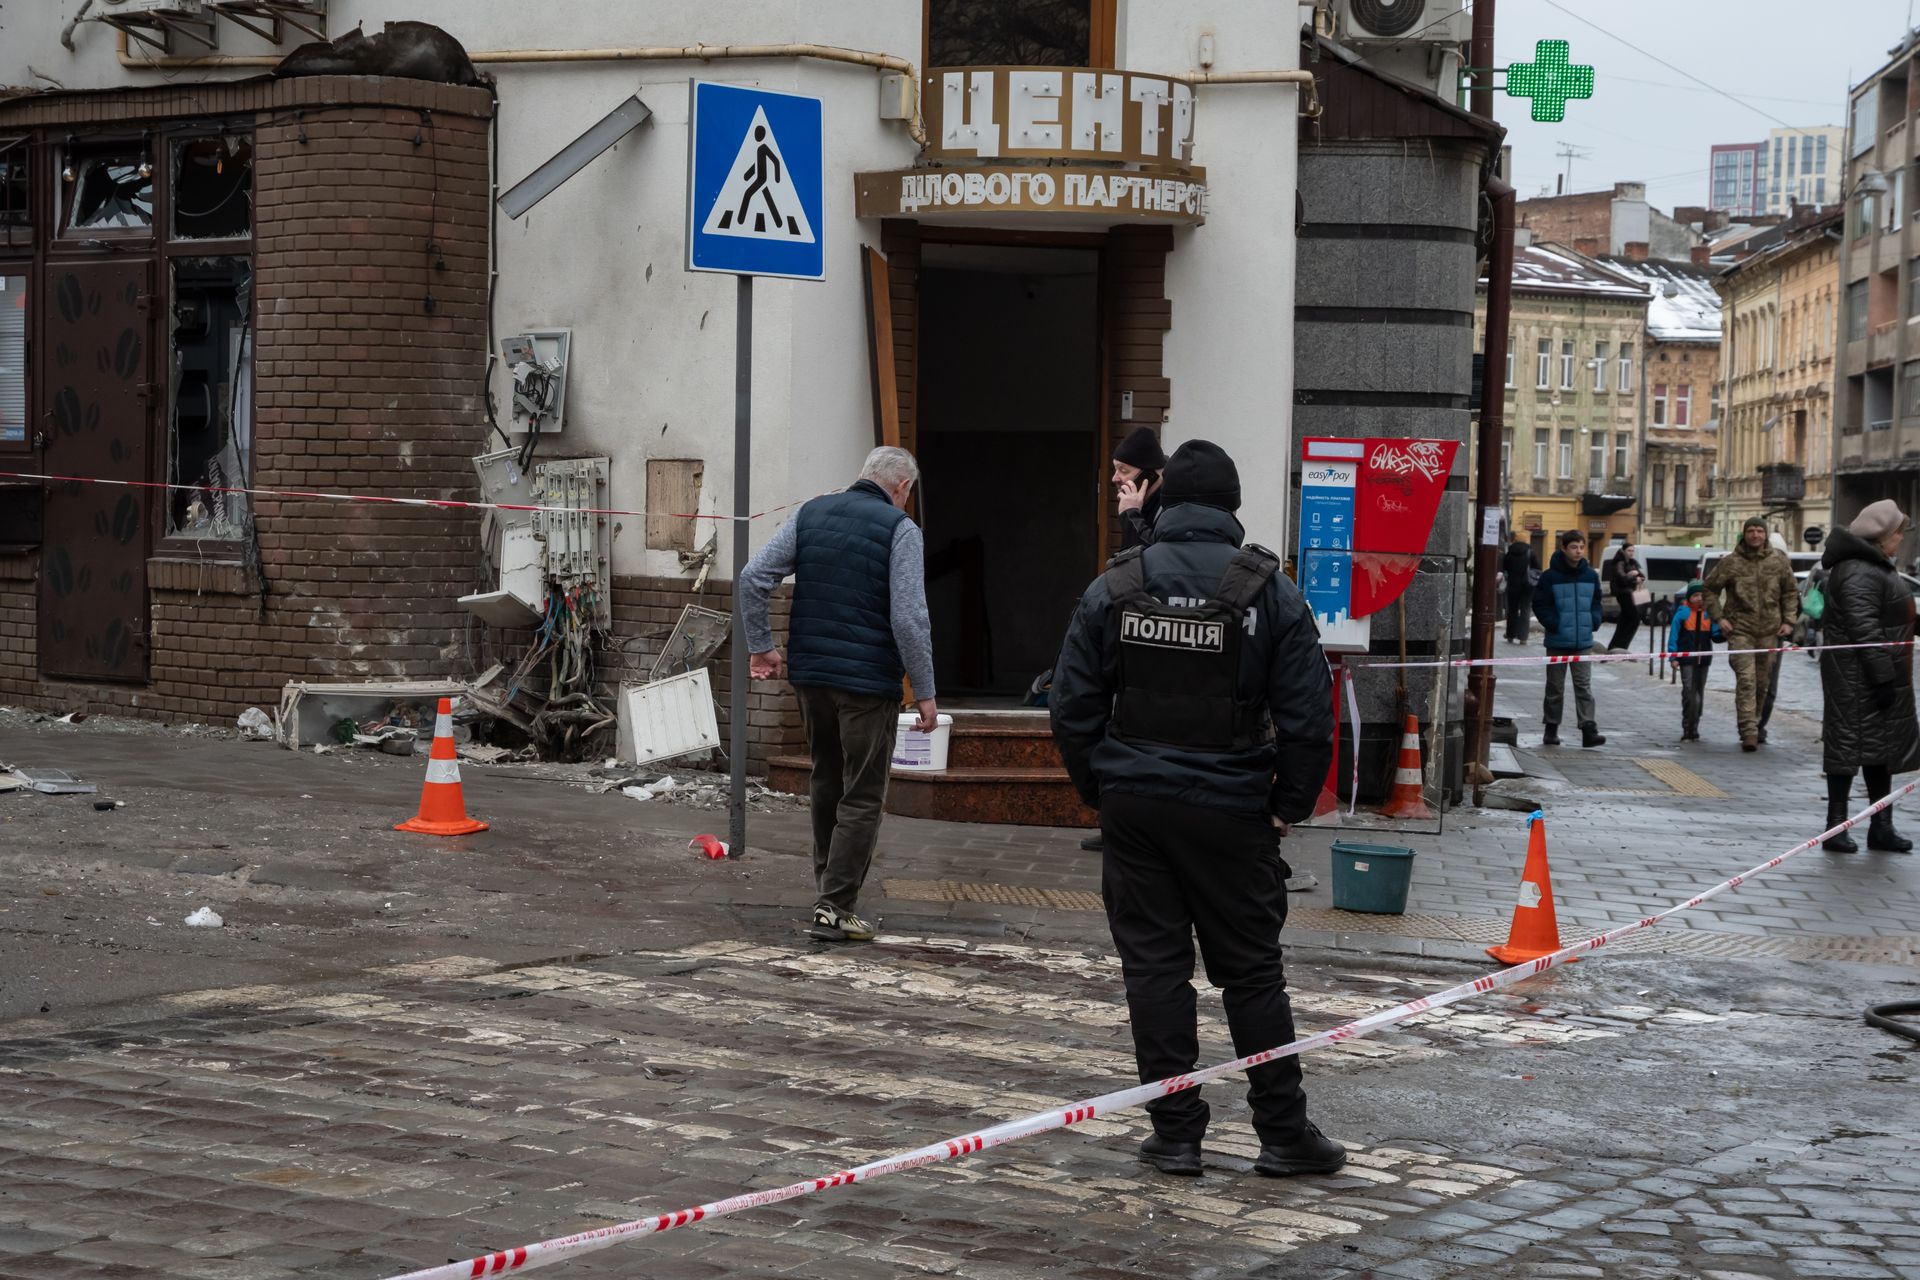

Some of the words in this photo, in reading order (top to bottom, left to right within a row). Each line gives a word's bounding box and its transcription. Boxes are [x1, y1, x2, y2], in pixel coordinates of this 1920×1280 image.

[942, 70, 1196, 160] ЦЕНТР
[899, 172, 1056, 213] ДІЛОВОГО
[1124, 616, 1221, 647] ПОЛІЦІЯ
